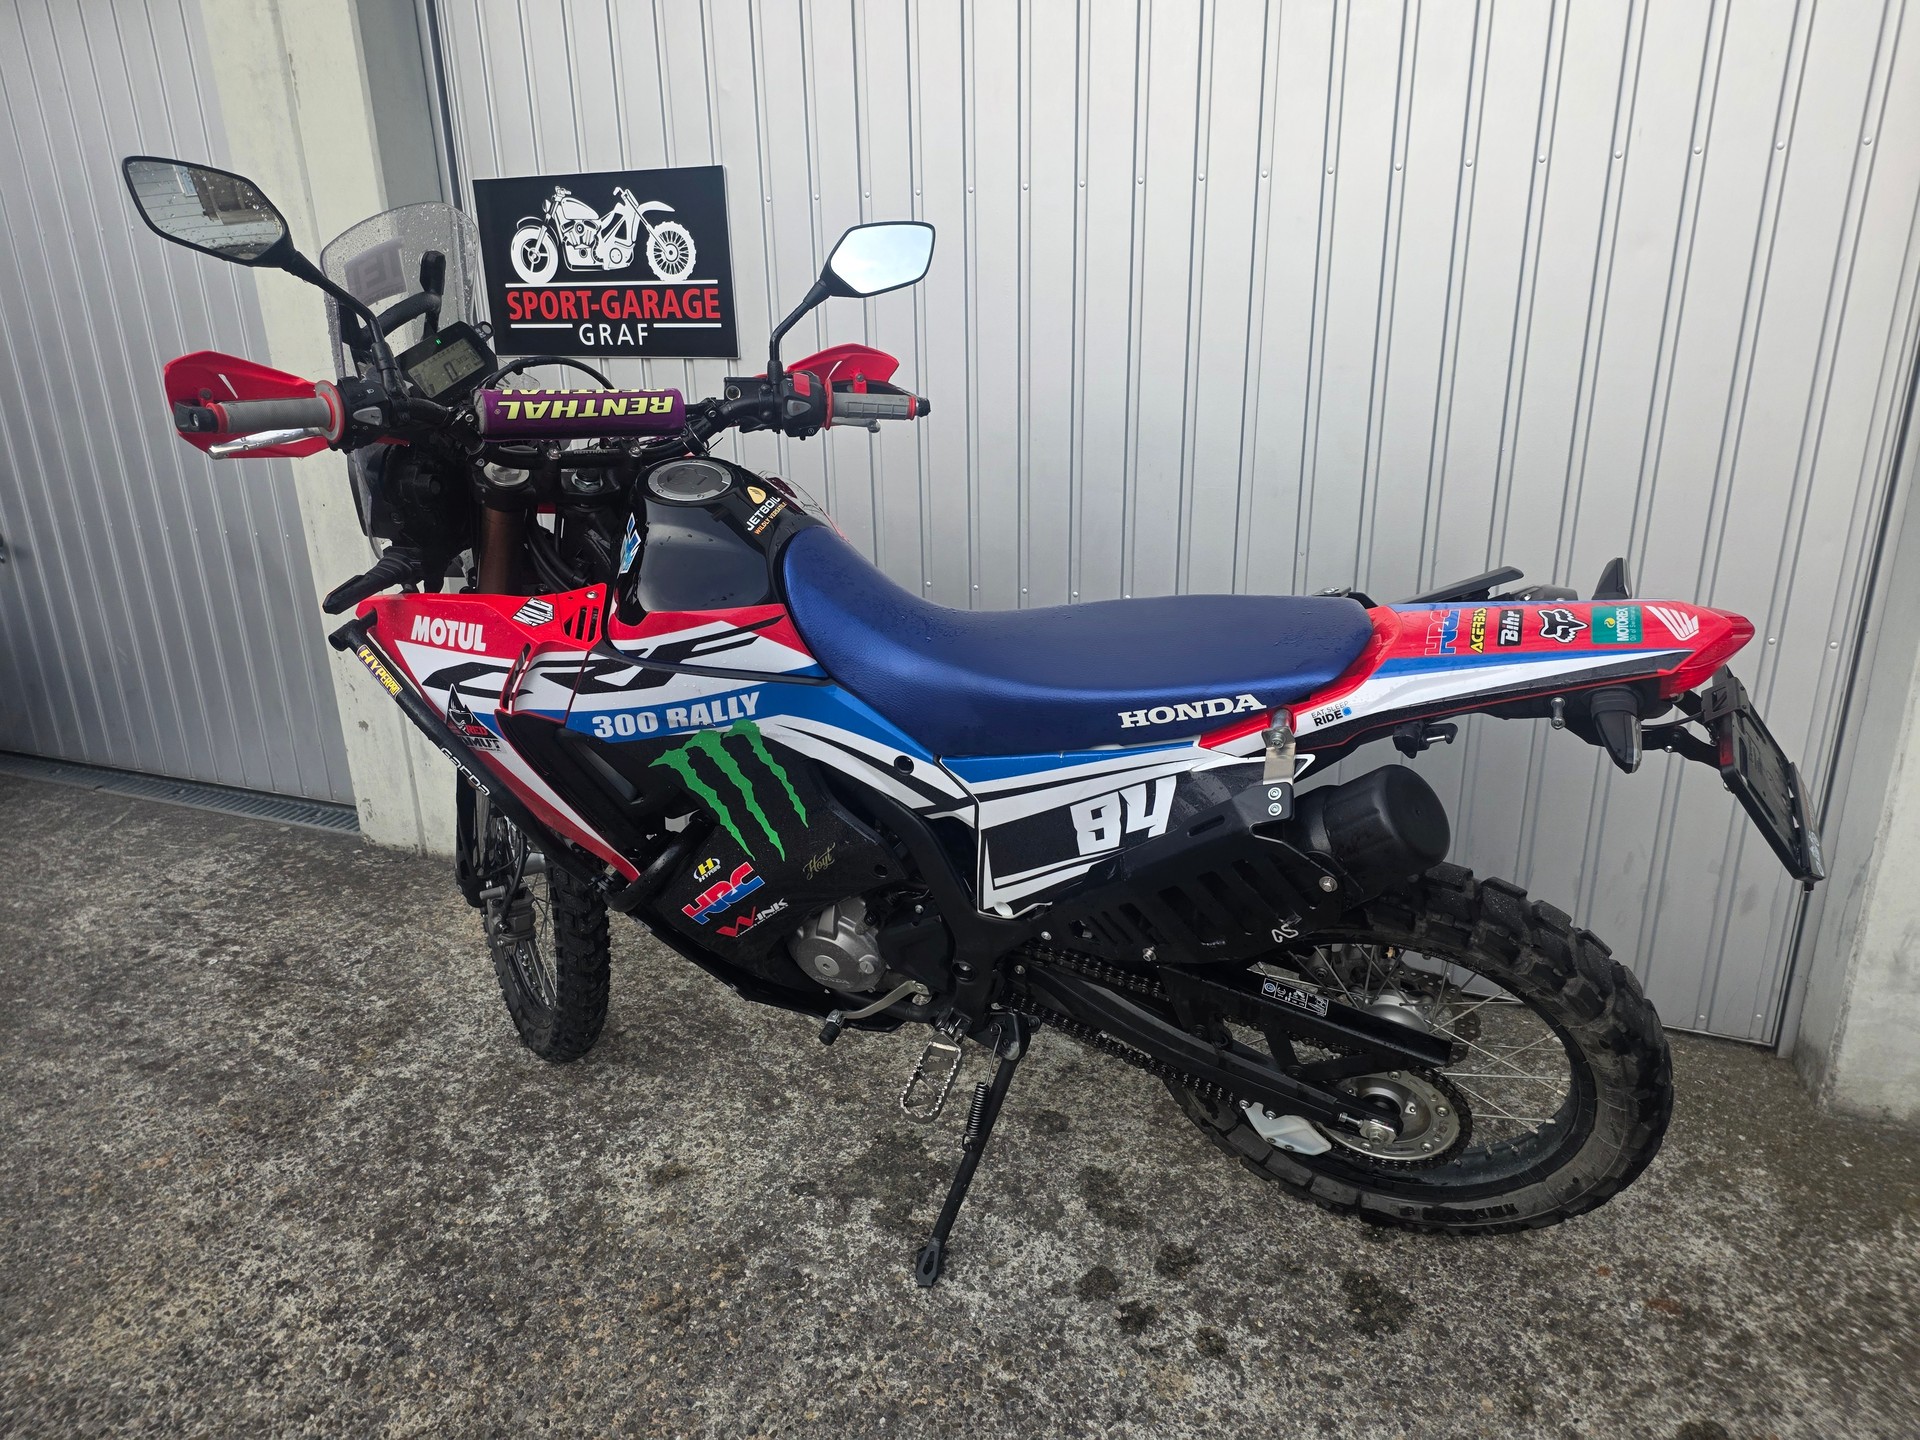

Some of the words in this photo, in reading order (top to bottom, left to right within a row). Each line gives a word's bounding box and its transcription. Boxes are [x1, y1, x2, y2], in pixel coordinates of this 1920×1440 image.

[506, 288, 721, 320] SPORT-GARAGE
[578, 323, 649, 346] GRAF
[498, 396, 674, 420] RENTHAL
[746, 496, 781, 531] JETBOIL
[410, 614, 487, 652] MOTUL
[1424, 609, 1460, 656] HRC
[1470, 607, 1488, 654] ACERBIS
[1500, 610, 1520, 645] Bihr
[1616, 607, 1629, 641] MOTOREX
[591, 711, 659, 738] 300
[666, 691, 760, 729] RALLY
[1117, 693, 1267, 729] HONDA
[1313, 709, 1343, 727] RIDE
[1069, 775, 1177, 856] 84
[681, 861, 766, 926] HRC
